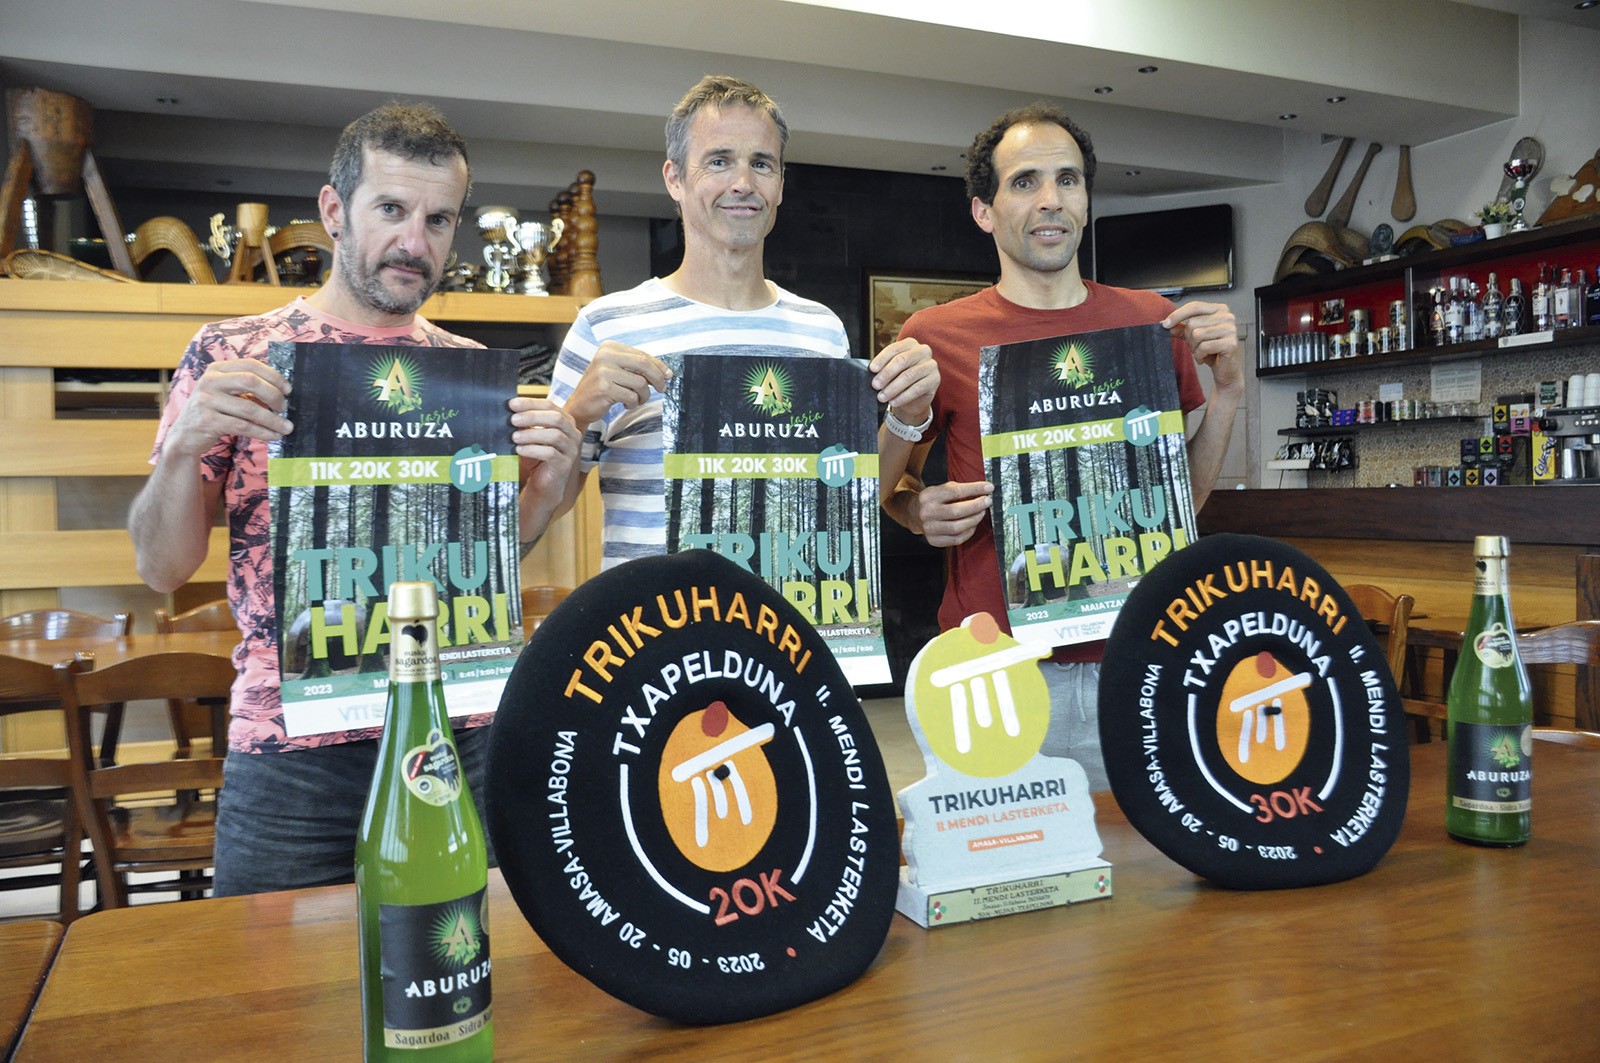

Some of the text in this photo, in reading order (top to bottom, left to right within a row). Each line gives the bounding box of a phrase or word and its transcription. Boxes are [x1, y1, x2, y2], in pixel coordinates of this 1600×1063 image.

[1028, 390, 1122, 414] ABURUZA
[335, 421, 454, 438] ABURUZA
[719, 422, 820, 438] ABURUZA
[1012, 422, 1115, 450] 11K 20K 30K
[309, 459, 440, 480] 11K 20K 30K
[697, 456, 808, 474] 11K 20K 30K
[1008, 485, 1168, 546] TRIKU
[293, 540, 489, 601] TRIKU
[1026, 609, 1049, 622] 2023
[1151, 559, 1349, 648] TRIKUHARRI
[564, 585, 813, 706] TRIKUHARRI
[827, 627, 871, 637] LASTERKETA
[462, 647, 512, 659] LASTERKETA
[1183, 611, 1335, 689] TXAPELDUNA
[303, 684, 334, 696] 2023
[612, 650, 798, 756] TXAPELDUNA
[1359, 669, 1388, 735] MENDI
[828, 715, 867, 790] MENDI
[1139, 663, 1186, 814] AMASA-VILLABONA
[1466, 769, 1531, 783] ABURUZA
[928, 778, 1067, 814] TRIKUHARRI
[1249, 786, 1324, 824] 30K
[1330, 742, 1390, 848] LASTERKETA
[547, 730, 621, 926] AMASA-VILLABONA
[948, 815, 990, 830] MENDI
[993, 802, 1070, 823] LASTERKETA
[1181, 812, 1204, 833] 20
[1218, 834, 1239, 852] 05
[1257, 845, 1298, 860] 2023
[806, 802, 871, 944] LASTERKETA
[709, 868, 798, 927] 20K
[986, 880, 1044, 895] TRIKUHARRI
[618, 921, 647, 949] 20
[667, 947, 692, 969] 05
[717, 952, 766, 974] 2023
[404, 957, 492, 999] ABURUZA
[395, 1018, 482, 1045] Sagardoa Sidra
